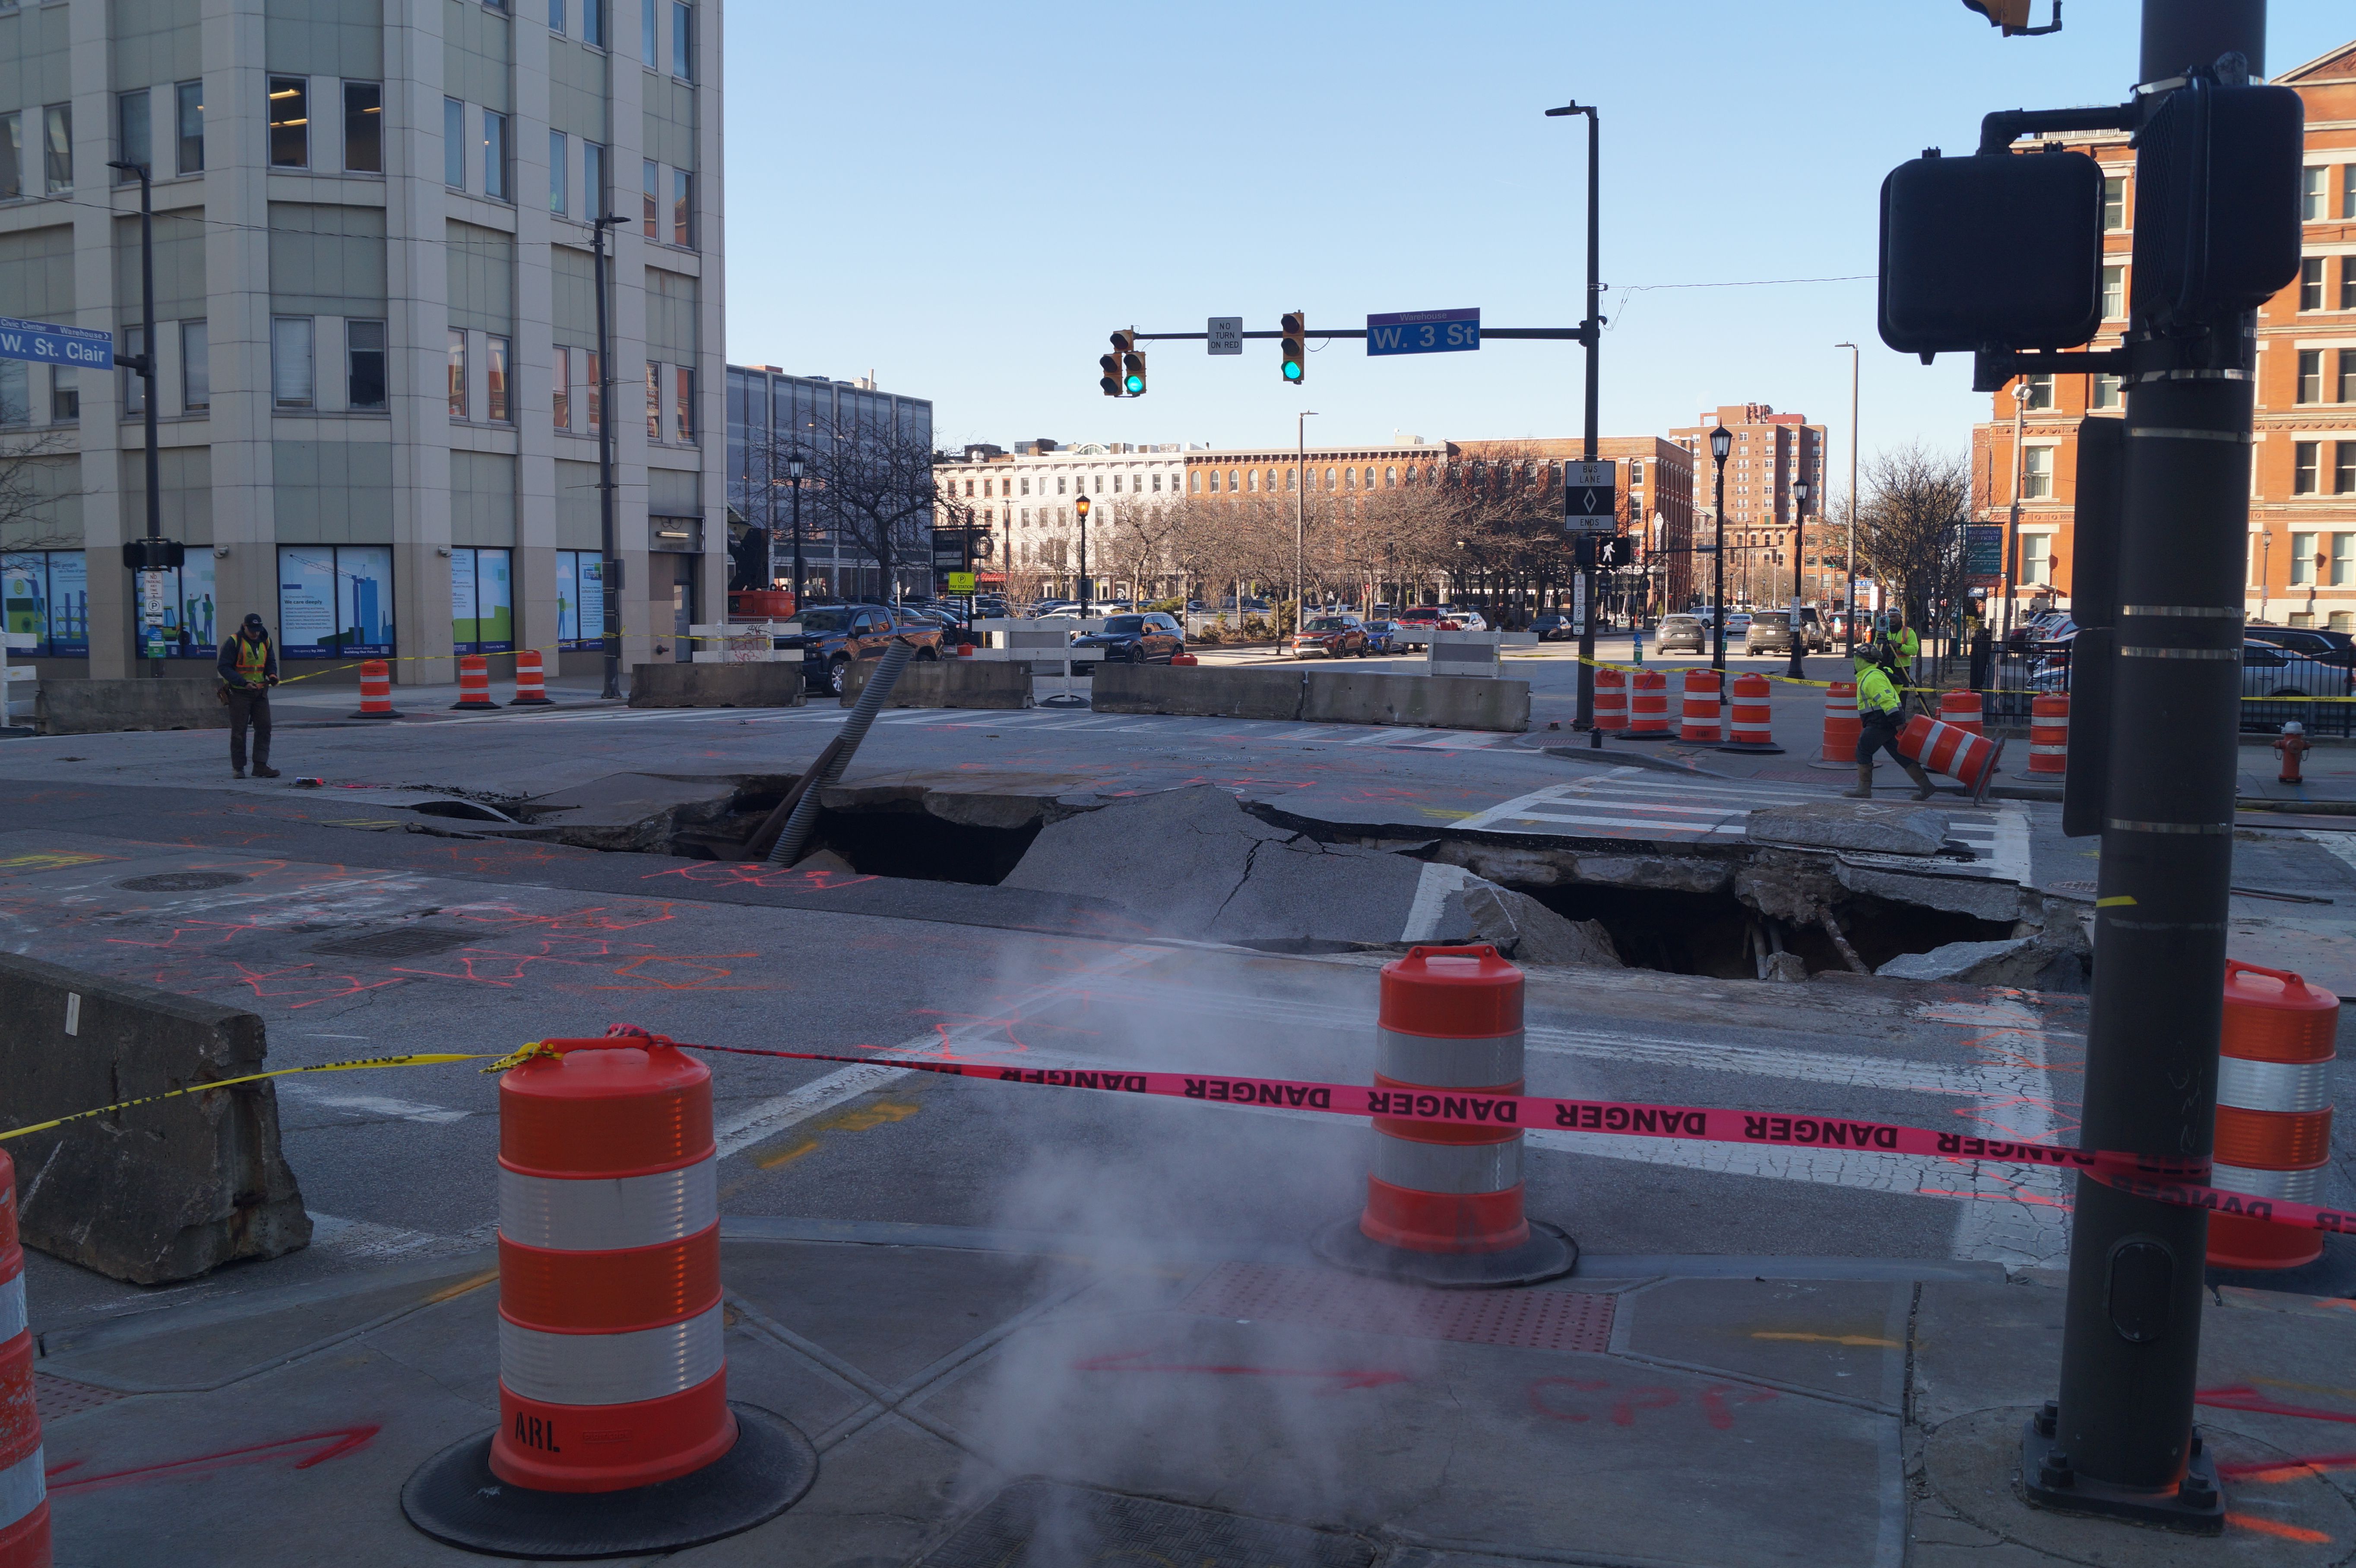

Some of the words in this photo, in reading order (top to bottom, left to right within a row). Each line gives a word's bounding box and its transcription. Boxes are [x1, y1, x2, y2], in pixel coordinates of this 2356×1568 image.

[1, 318, 19, 328] Civic
[22, 321, 47, 331] Center
[60, 326, 102, 339] Warehouse
[1400, 312, 1447, 321] Warehouse
[0, 333, 27, 353] W.
[35, 338, 59, 357] St.
[66, 341, 104, 362] Clair
[1373, 327, 1407, 349] W.
[1419, 326, 1435, 347] 3
[1447, 324, 1474, 345] St
[999, 1070, 1146, 1093] DANGER
[1184, 1078, 1331, 1109] DANGER
[1368, 1091, 1518, 1122] DANGER
[1555, 1103, 1707, 1136] DANGER
[1744, 1115, 1898, 1148] DANGER
[516, 1411, 560, 1453] ARL
